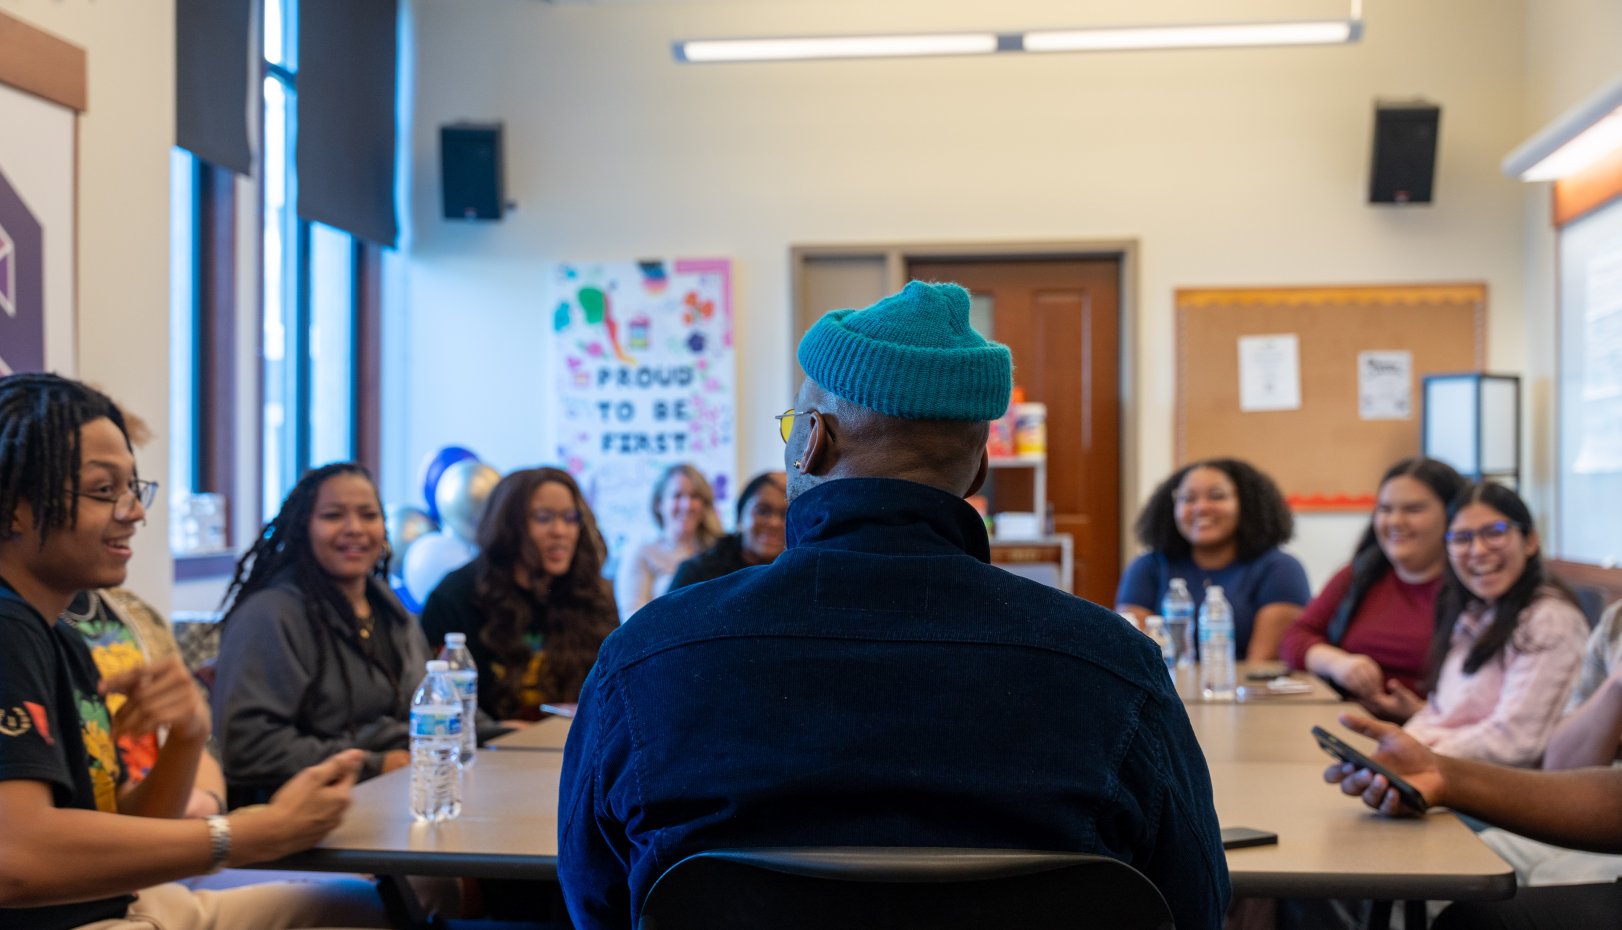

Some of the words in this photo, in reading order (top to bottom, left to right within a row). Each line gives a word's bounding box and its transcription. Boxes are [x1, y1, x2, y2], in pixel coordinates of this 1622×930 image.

[597, 366, 692, 388] PROUD
[598, 401, 634, 422] TO
[654, 401, 689, 422] BE
[602, 433, 687, 454] FIRST
